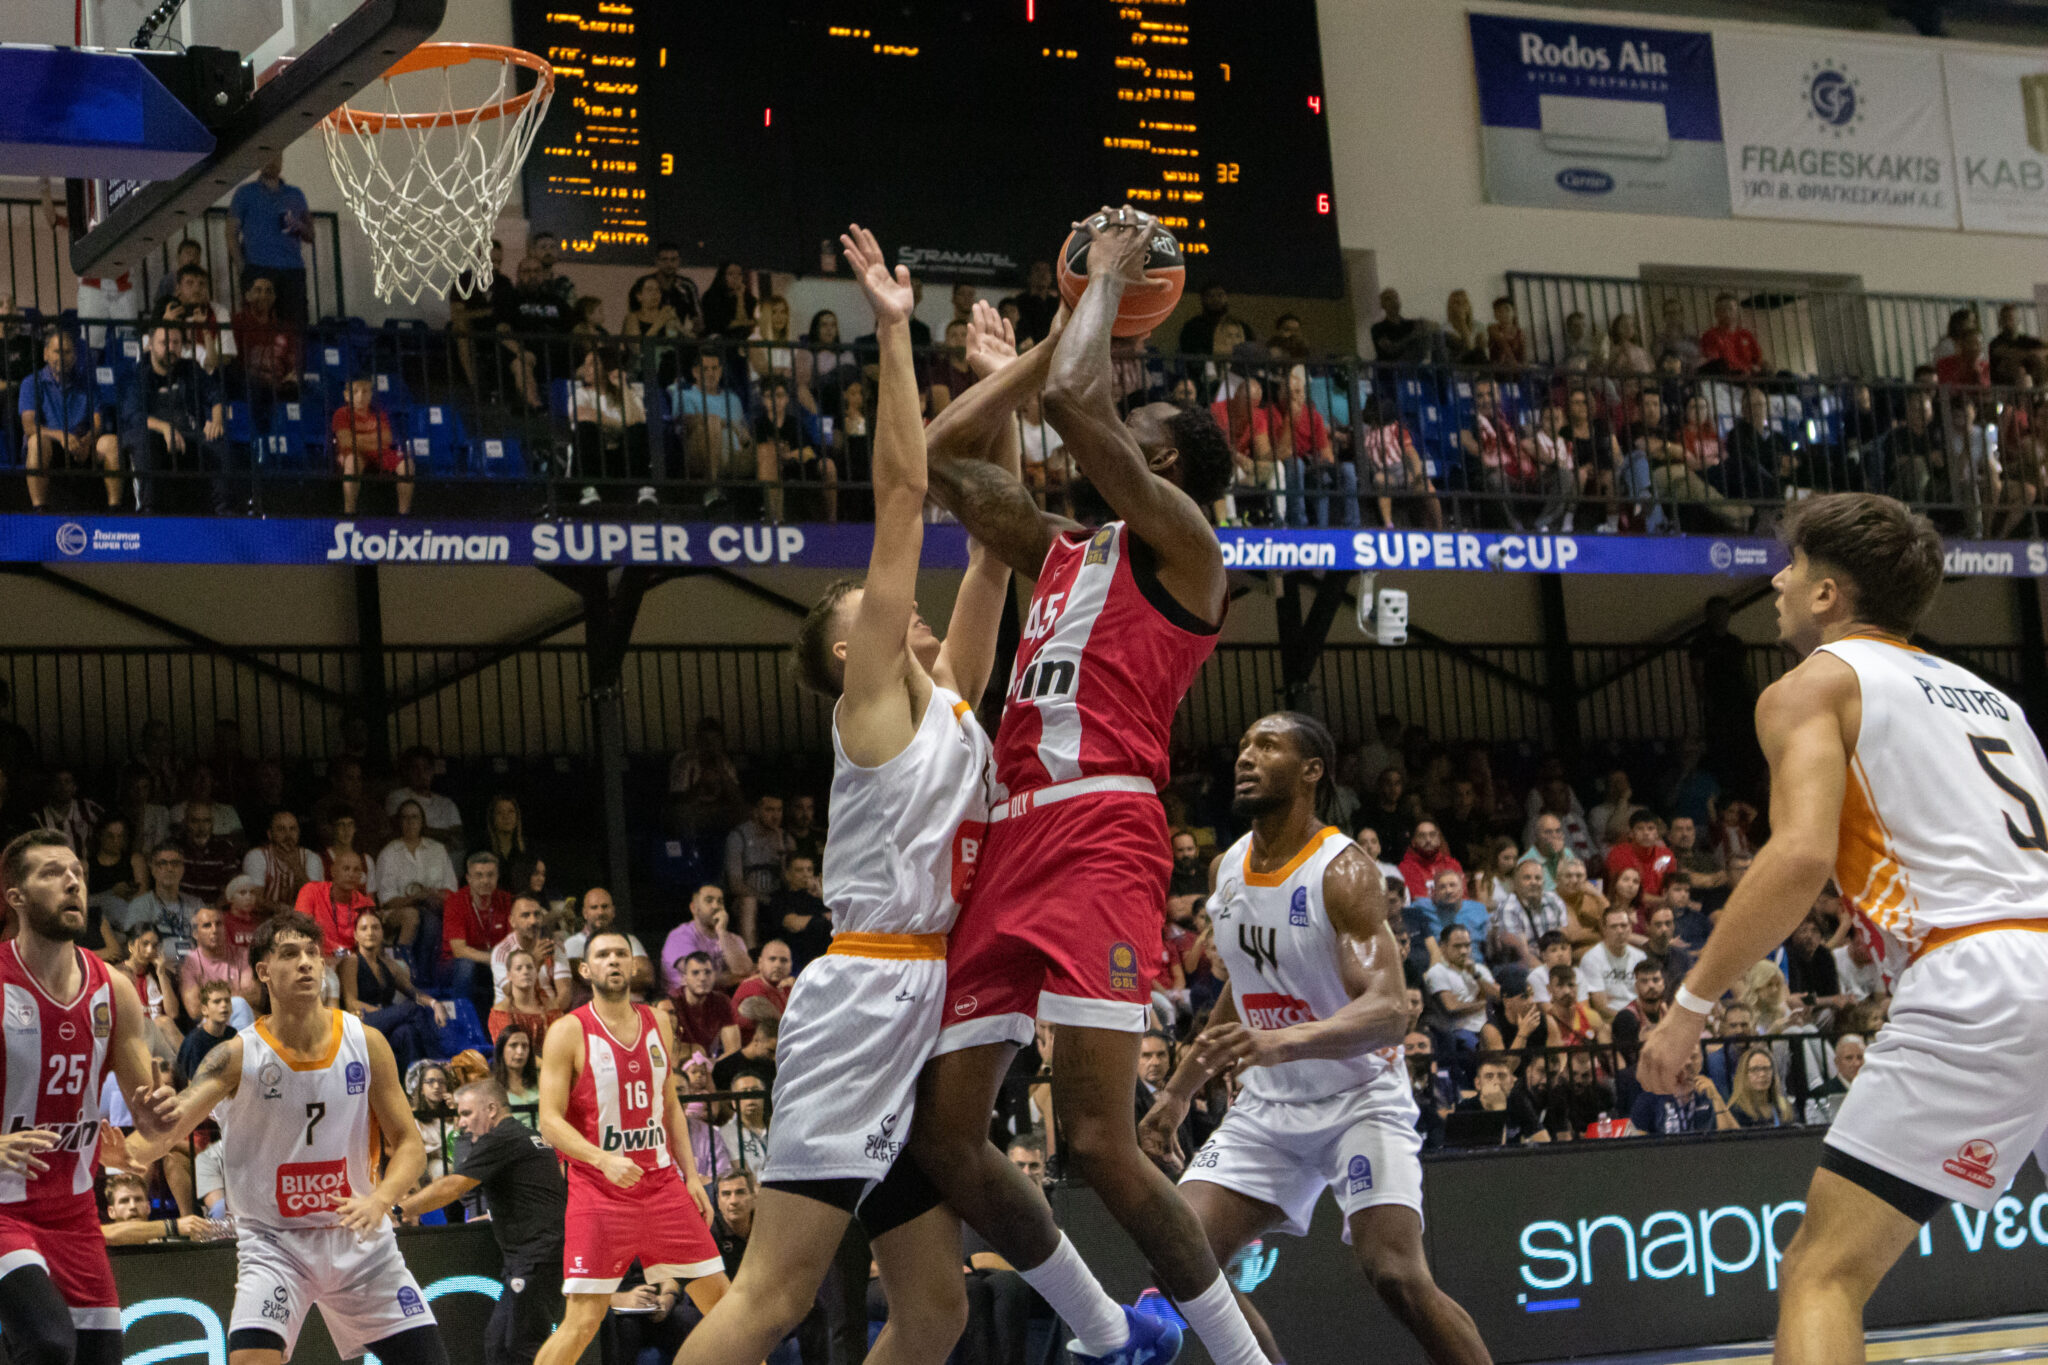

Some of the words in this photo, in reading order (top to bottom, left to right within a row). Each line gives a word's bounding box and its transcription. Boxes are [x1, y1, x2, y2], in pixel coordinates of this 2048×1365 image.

[1520, 32, 1611, 71] Rodos
[661, 153, 674, 175] 3
[1216, 163, 1240, 183] 32
[1741, 145, 1941, 184] FRAGESKAKIS
[1317, 193, 1329, 214] 6
[327, 522, 510, 560] Stoiximan
[532, 525, 691, 561] SUPER
[708, 525, 805, 563] CUP
[1220, 537, 1335, 567] oiximan
[1353, 533, 1484, 567] SUPER
[1500, 536, 1578, 570] CUP
[1023, 592, 1066, 646] 45
[1966, 731, 2048, 854] 5
[1112, 977, 1137, 989] GBL
[46, 1053, 87, 1096] 25
[624, 1080, 649, 1111] 16
[306, 1101, 326, 1146] 7
[602, 1118, 666, 1152] bwin
[1518, 1200, 1808, 1297] snapp
[405, 1305, 425, 1316] GBL
